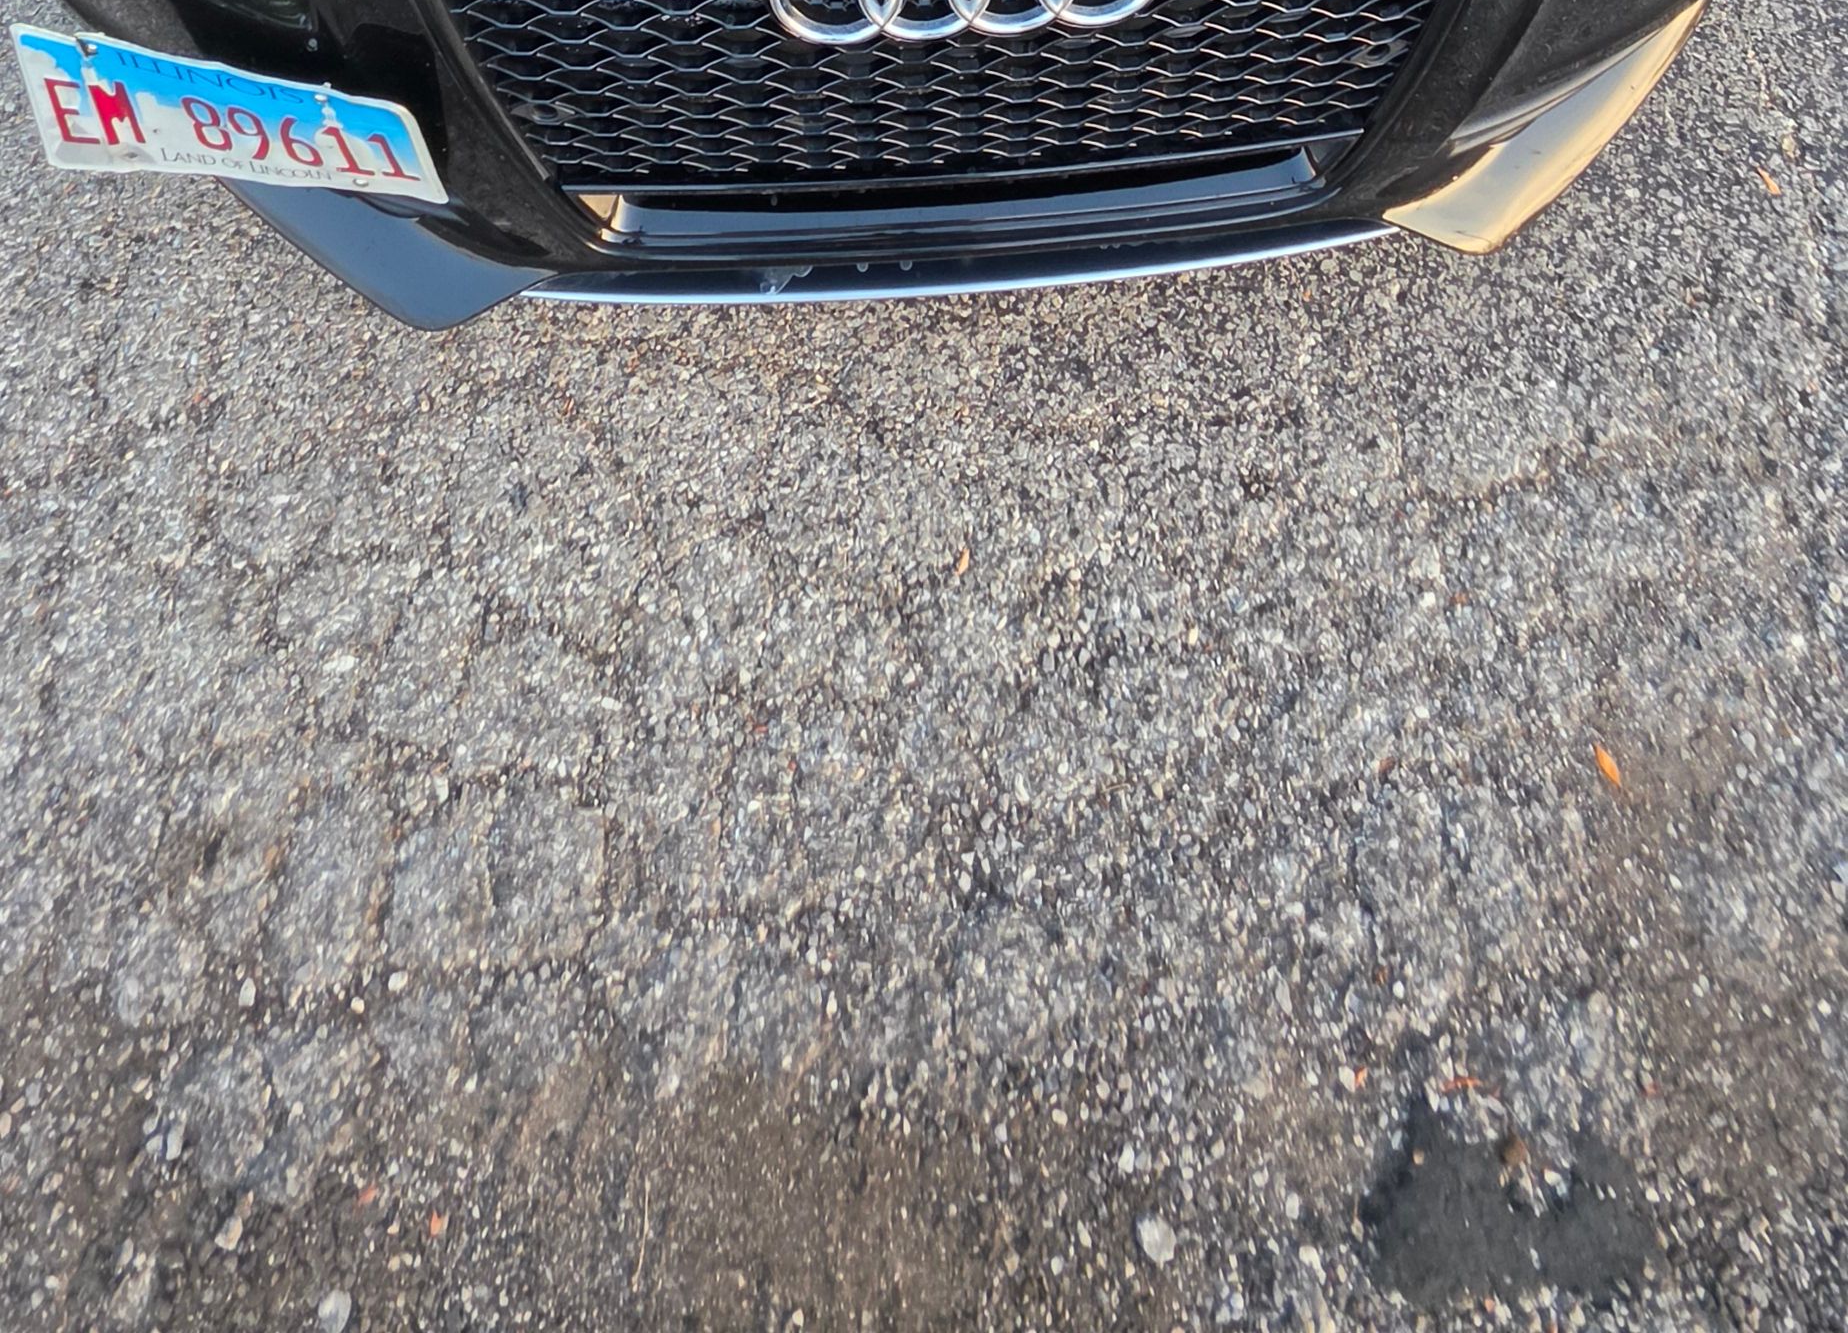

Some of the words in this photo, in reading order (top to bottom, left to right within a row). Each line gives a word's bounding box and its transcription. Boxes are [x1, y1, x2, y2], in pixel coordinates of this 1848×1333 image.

[116, 50, 305, 105] ILLINOIS
[44, 77, 146, 147] EM
[180, 95, 421, 182] 89611
